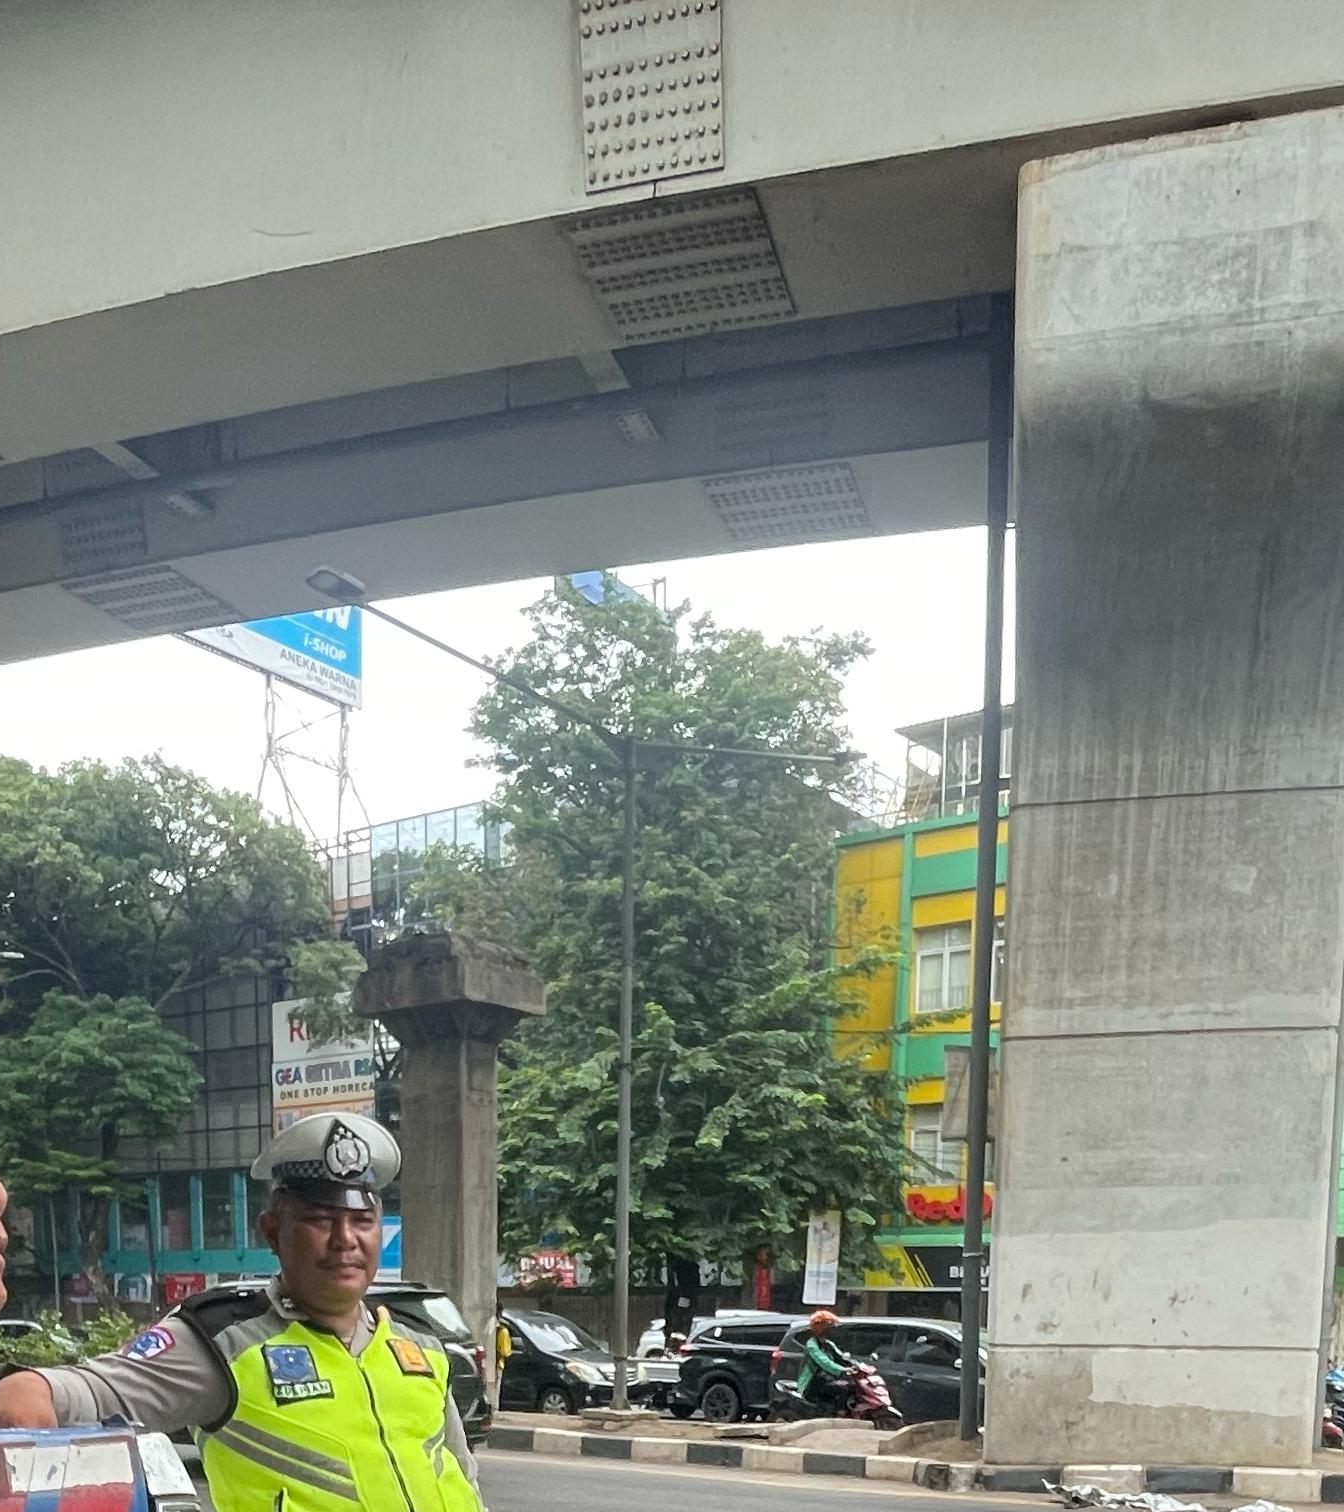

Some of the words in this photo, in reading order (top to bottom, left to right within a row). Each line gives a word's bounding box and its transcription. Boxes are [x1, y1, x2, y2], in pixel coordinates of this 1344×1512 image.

[304, 632, 348, 662] i-SHOP
[280, 648, 317, 674] ANEKA
[320, 665, 356, 691] WARNA
[275, 1066, 303, 1086] GEA
[279, 1090, 300, 1100] ONE
[304, 1086, 329, 1099] STOP
[332, 1081, 376, 1095] HORECA
